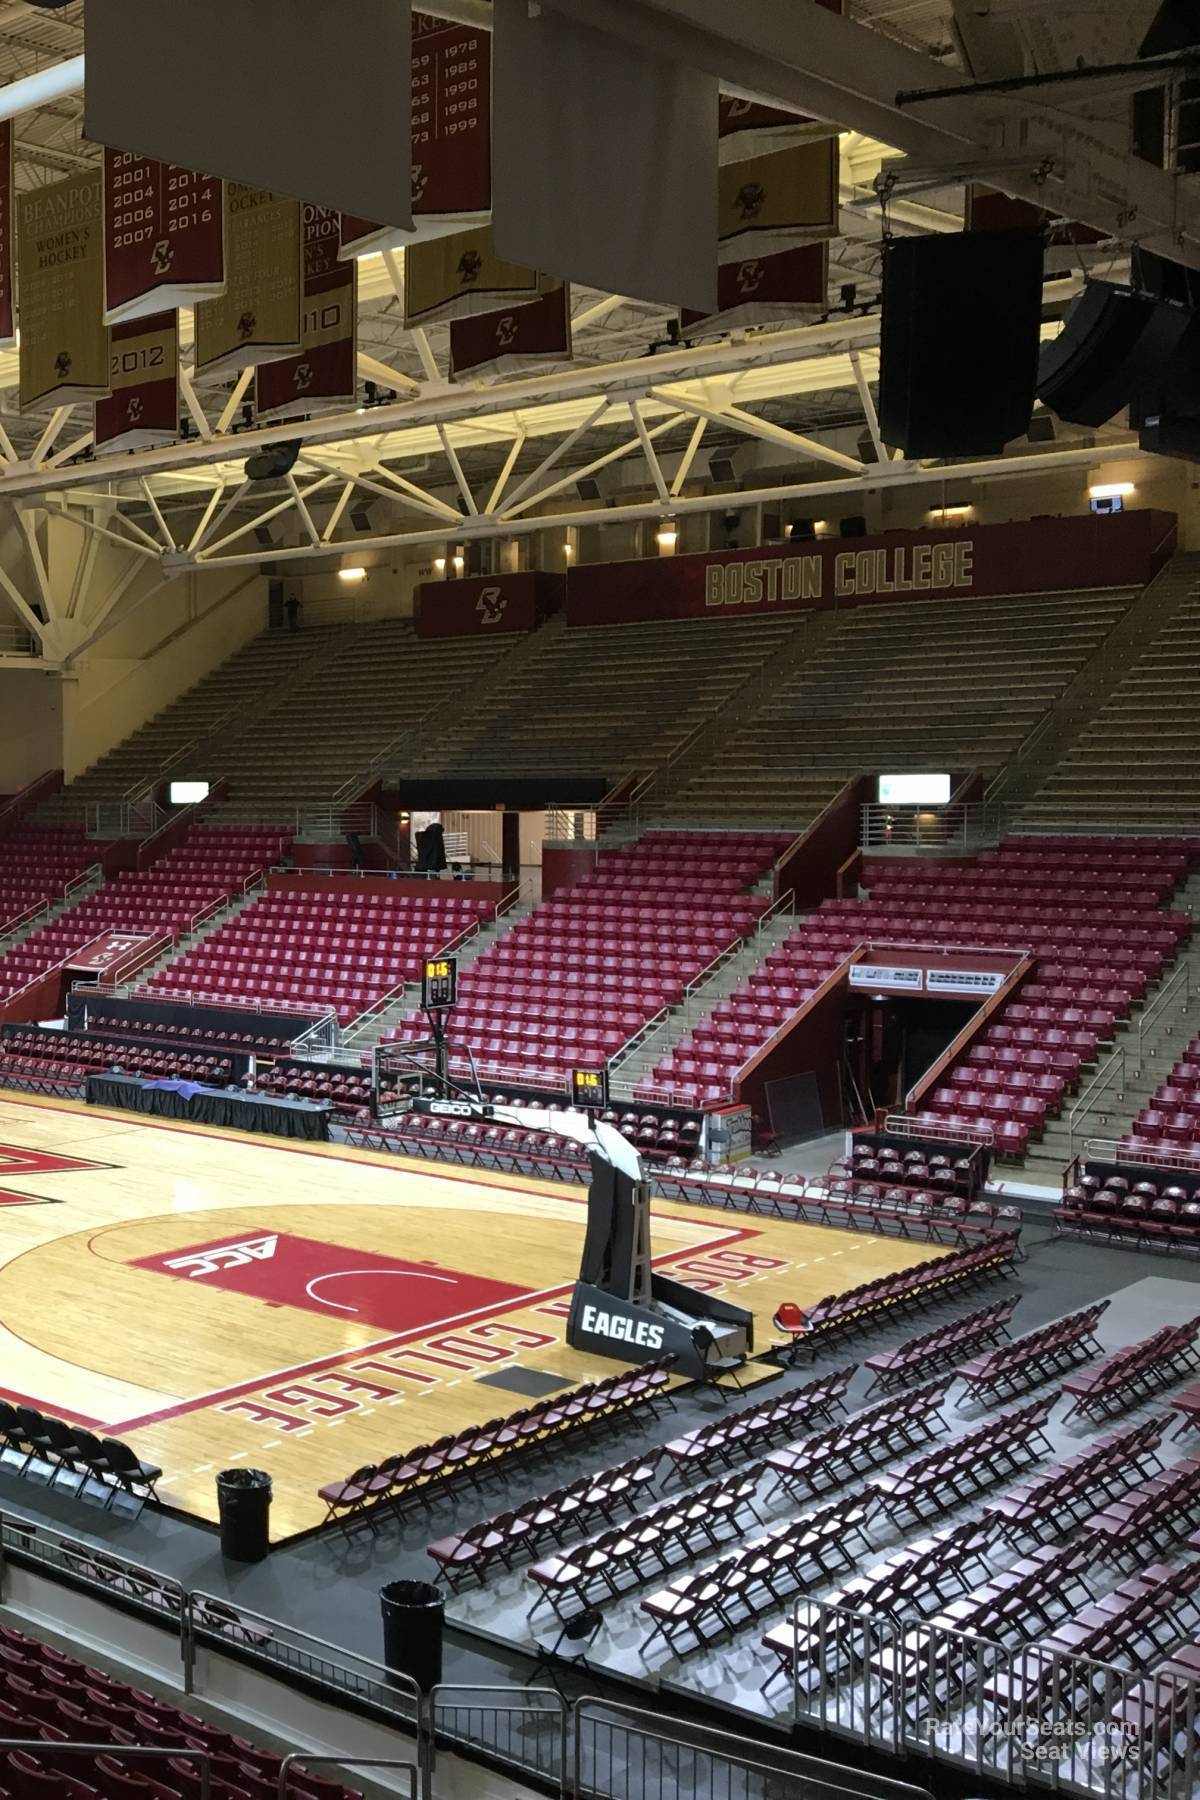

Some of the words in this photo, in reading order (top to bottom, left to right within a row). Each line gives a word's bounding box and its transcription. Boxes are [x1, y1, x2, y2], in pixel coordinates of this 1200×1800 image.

[444, 40, 478, 58] 1978
[444, 59, 478, 79] 1985
[444, 79, 478, 97] 1990
[444, 98, 478, 117] 1998
[444, 118, 478, 136] 1999
[113, 166, 154, 188] 2001
[24, 183, 101, 223] BEANPOT
[113, 186, 154, 208] 2004
[168, 188, 212, 211] 2014
[26, 204, 100, 236] CHAMPIONS
[113, 206, 154, 228] 2006
[168, 209, 212, 232] 2016
[36, 227, 90, 252] WOMEN'S
[113, 226, 154, 248] 2007
[39, 244, 87, 269] HOCKEY
[705, 555, 823, 606] BOSTON
[834, 541, 973, 597] COLLEGE
[430, 1102, 471, 1116] GEICO
[164, 1235, 278, 1277] ACC
[582, 1304, 664, 1349] EAGLES
[214, 1321, 561, 1438] COLLEGE
